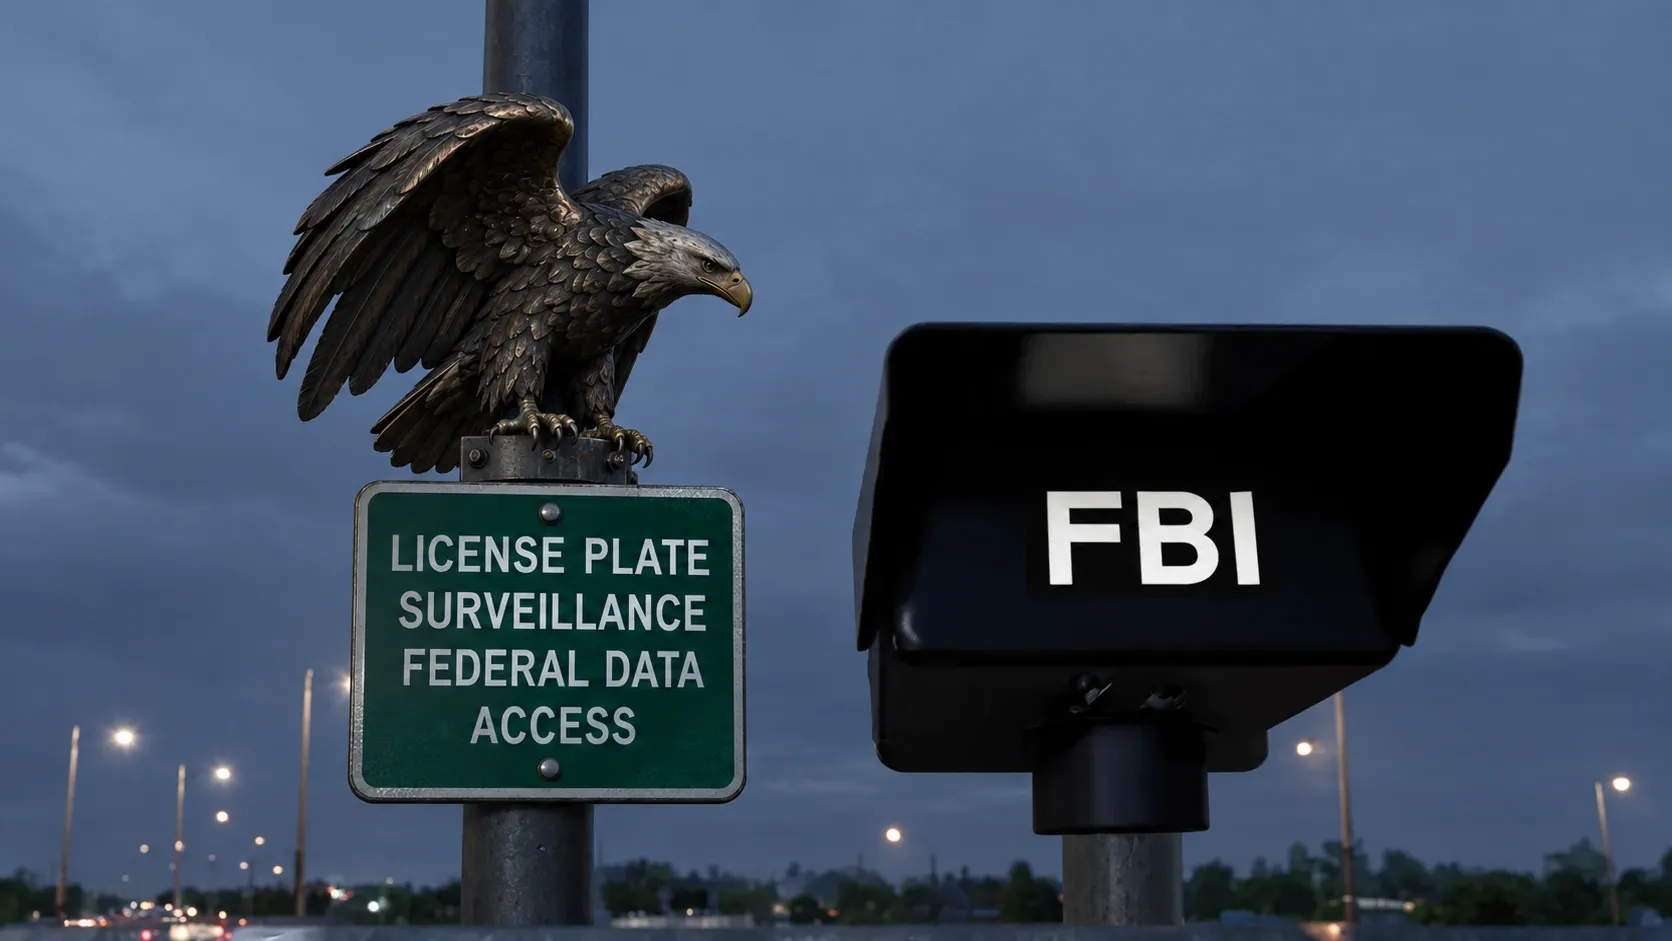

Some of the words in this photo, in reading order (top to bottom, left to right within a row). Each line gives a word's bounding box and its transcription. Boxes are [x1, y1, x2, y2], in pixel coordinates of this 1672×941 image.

[391, 534, 565, 574] LICENSE
[585, 537, 710, 576] PLATE
[1046, 490, 1261, 586] FBI
[398, 590, 707, 632] SURVEILLANCE
[402, 648, 589, 687] FEDERAL
[605, 650, 705, 689] DATA
[470, 705, 637, 745] ACCESS
